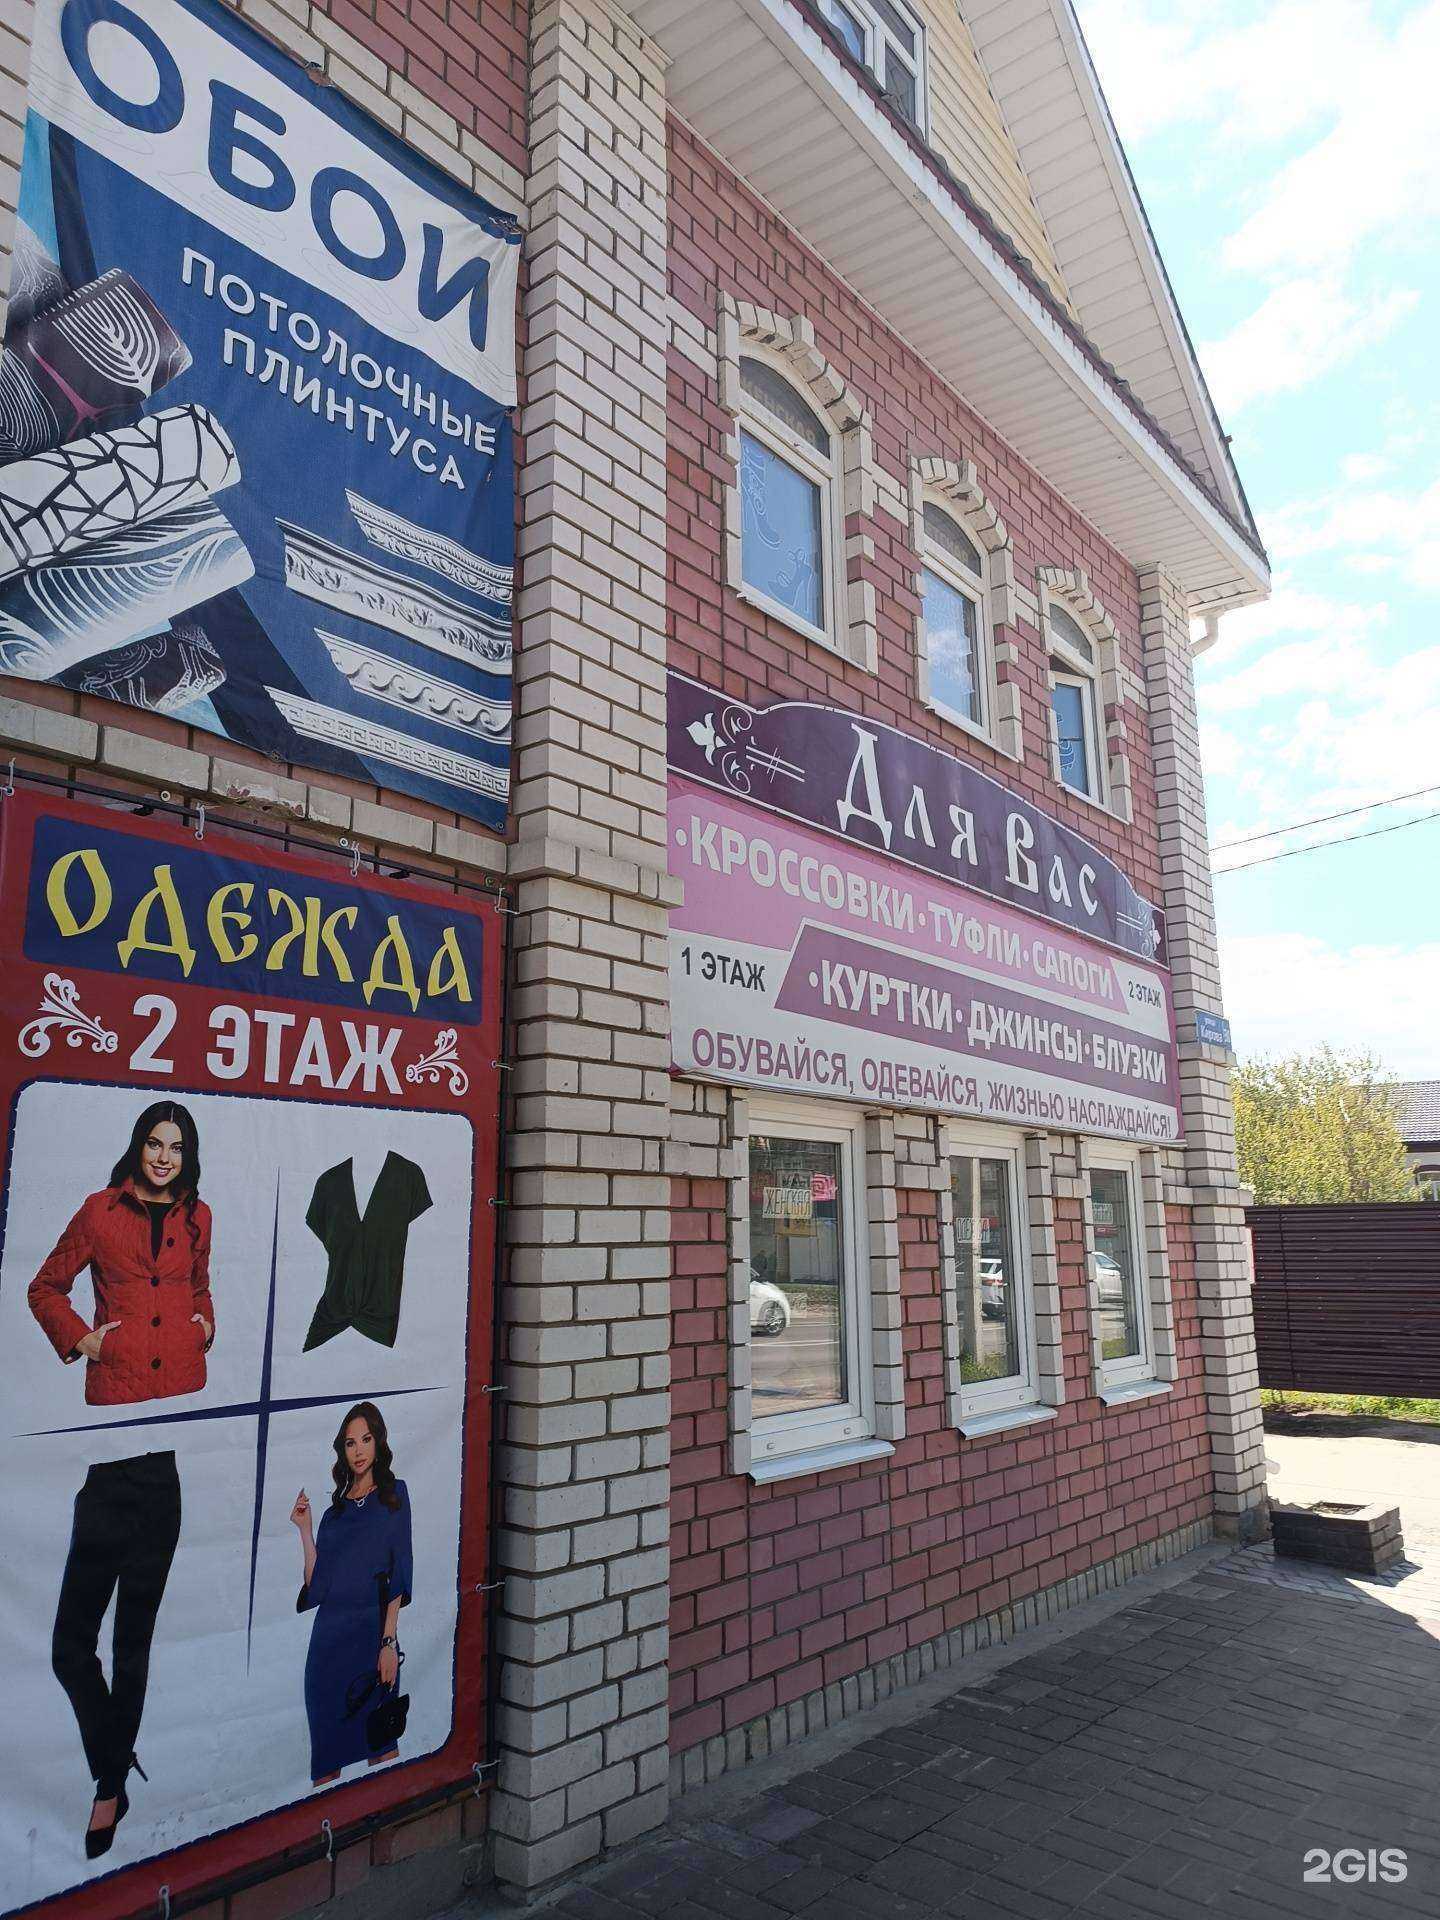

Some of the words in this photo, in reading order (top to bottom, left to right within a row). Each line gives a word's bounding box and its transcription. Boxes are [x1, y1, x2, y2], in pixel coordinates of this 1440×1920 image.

[61, 0, 490, 352] ОБОИ
[181, 246, 497, 456] ПОТОЛОЧНЫЕ
[223, 329, 466, 491] ПЛИНТУСА
[836, 722, 979, 866] Для
[1004, 811, 1099, 917] Вас
[46, 848, 473, 1013] ОДЕЖДА
[681, 946, 692, 976] 1
[701, 951, 766, 992] ЭТАЖ
[690, 815, 915, 934] КРОССОВКИ
[927, 901, 1022, 970] ТУФЛИ
[1032, 940, 1114, 1001] САПОГИ
[129, 994, 178, 1074] 2
[206, 1004, 403, 1095] ЭТАЖ
[821, 959, 953, 1034] КУРТКИ
[967, 1000, 1083, 1065] ДЖИНСЫ
[1092, 1033, 1167, 1085] БЛУЗКИ
[1128, 979, 1136, 999] 2
[1136, 984, 1162, 1009] ЭТАЖ
[692, 1028, 854, 1094] ОБУВАЙСЯ,
[861, 1057, 983, 1114] ОДЕВАЙСЯ,
[988, 1080, 1065, 1120] ЖИЗНЬЮ
[1068, 1096, 1172, 1139] НАСЛАЖДАЙСЯ!
